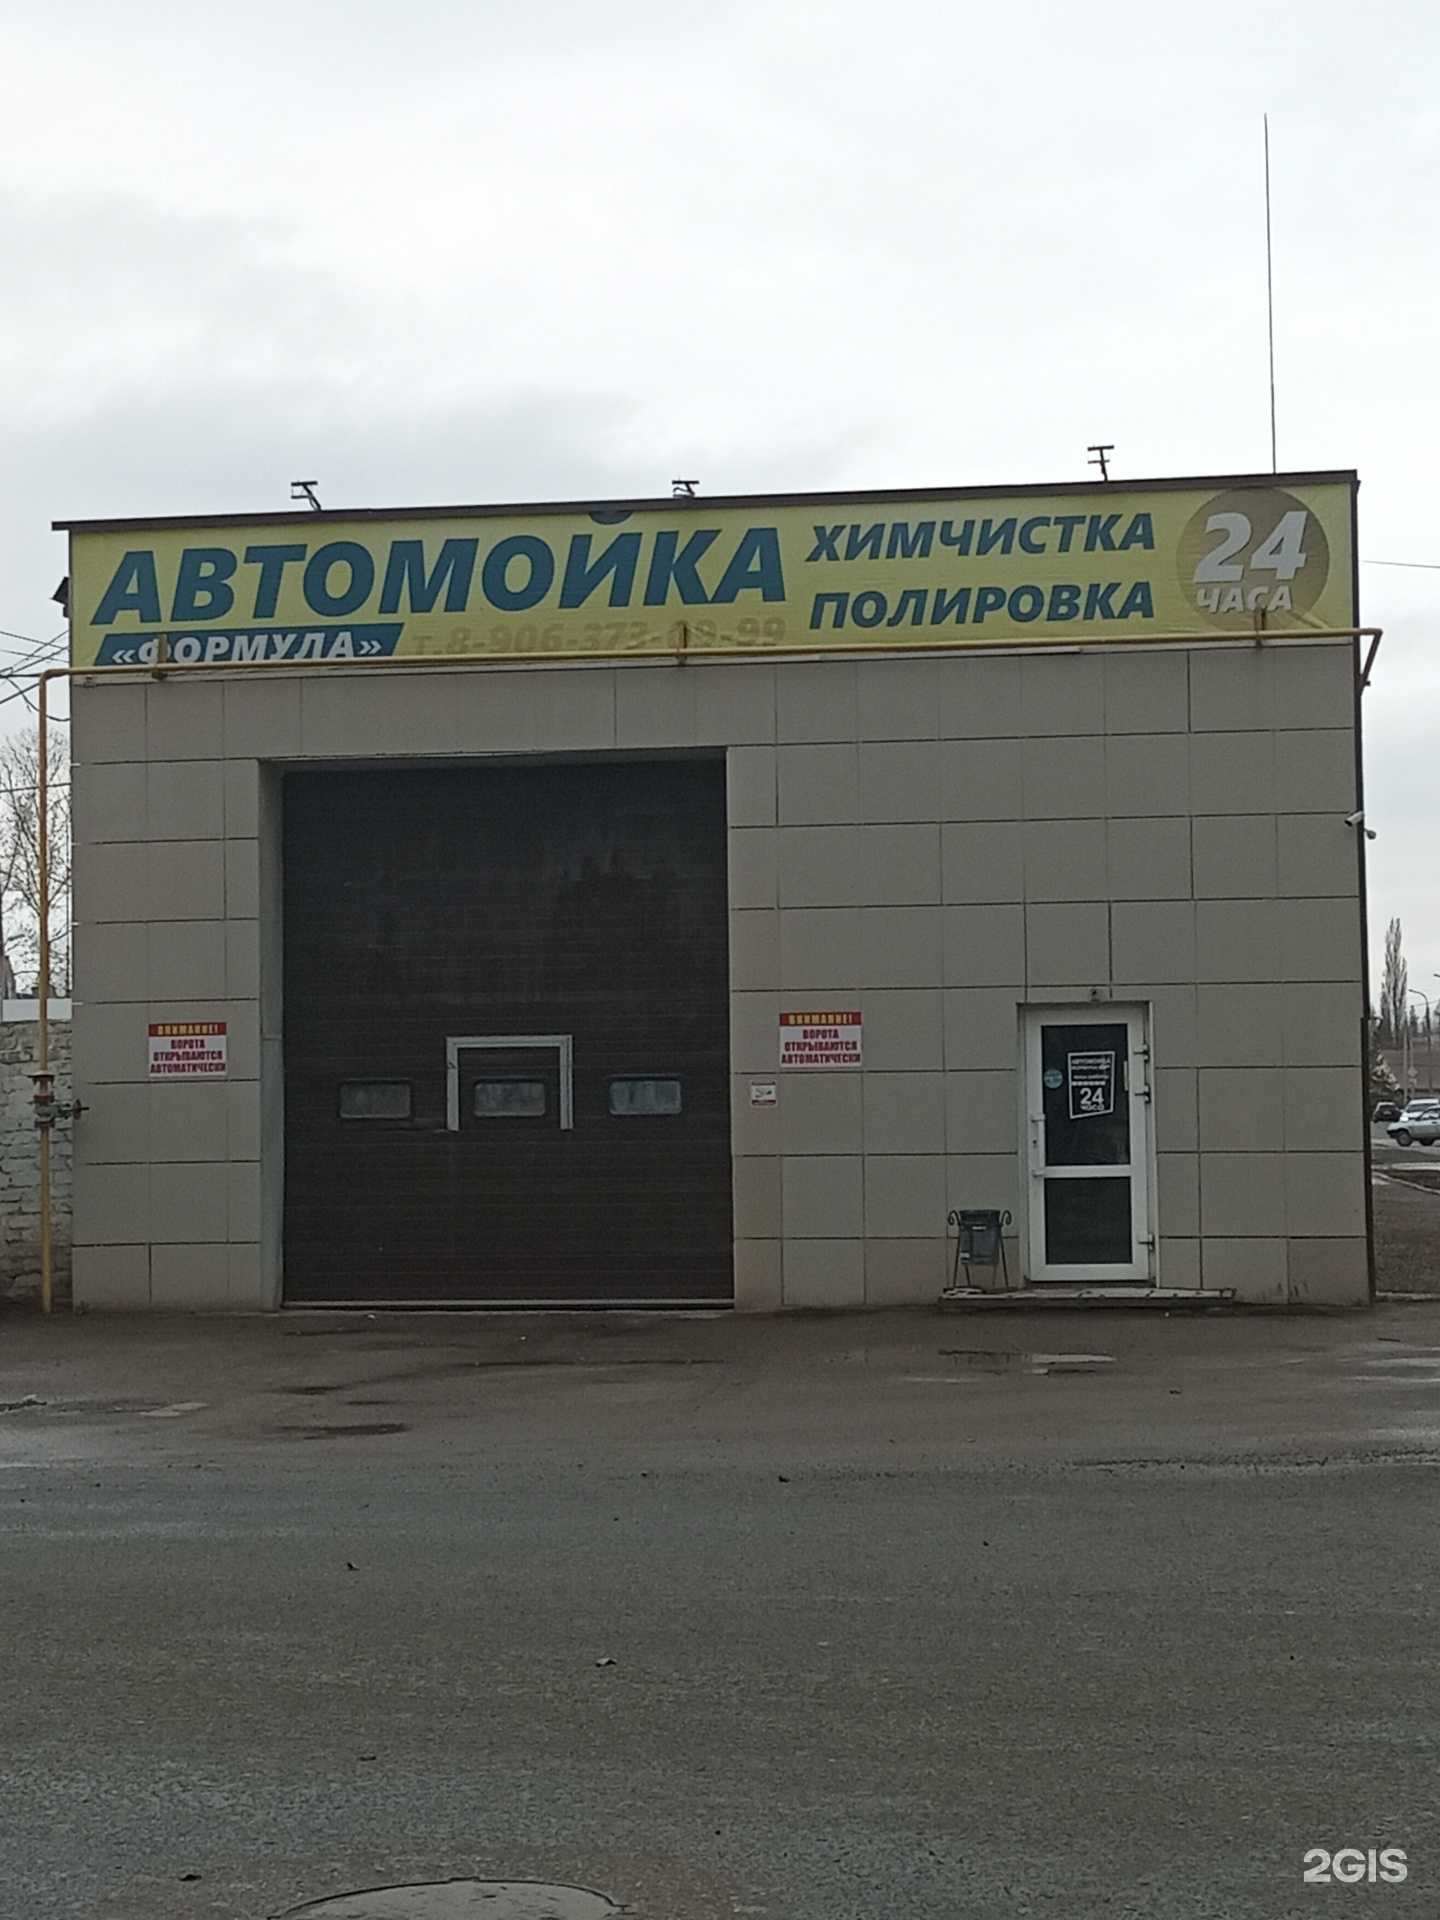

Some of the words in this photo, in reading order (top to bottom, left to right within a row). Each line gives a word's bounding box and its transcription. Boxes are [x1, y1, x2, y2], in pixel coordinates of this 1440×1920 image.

[805, 512, 1155, 562] ХИМЧИСТКА
[1194, 511, 1308, 583] 24
[90, 510, 786, 625] АВТОМОЙКА
[809, 581, 1155, 630] ПОЛИРОВКА
[1197, 585, 1292, 613] ЧАСА
[1080, 1087, 1104, 1105] 24
